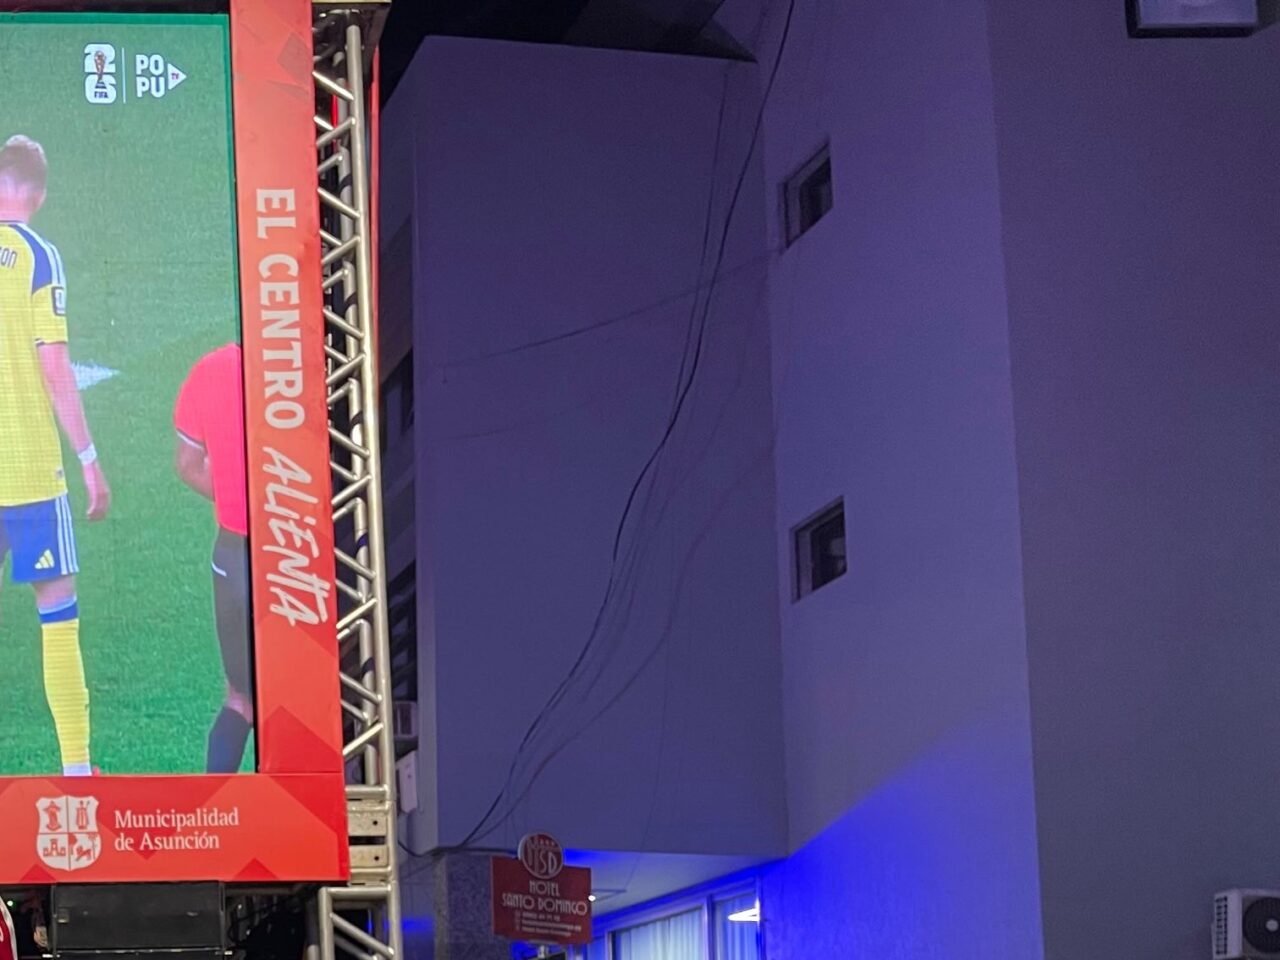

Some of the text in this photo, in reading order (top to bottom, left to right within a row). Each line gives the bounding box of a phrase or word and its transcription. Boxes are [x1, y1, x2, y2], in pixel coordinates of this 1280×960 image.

[135, 54, 164, 76] PO
[136, 76, 165, 98] PU
[256, 188, 296, 240] EL
[257, 253, 305, 430] CENTRO
[114, 806, 239, 833] Municipalidad
[114, 830, 220, 852] de Asunción
[529, 879, 560, 897] HOTEL
[501, 892, 535, 910] SANTO
[537, 897, 588, 916] DOMINGO
